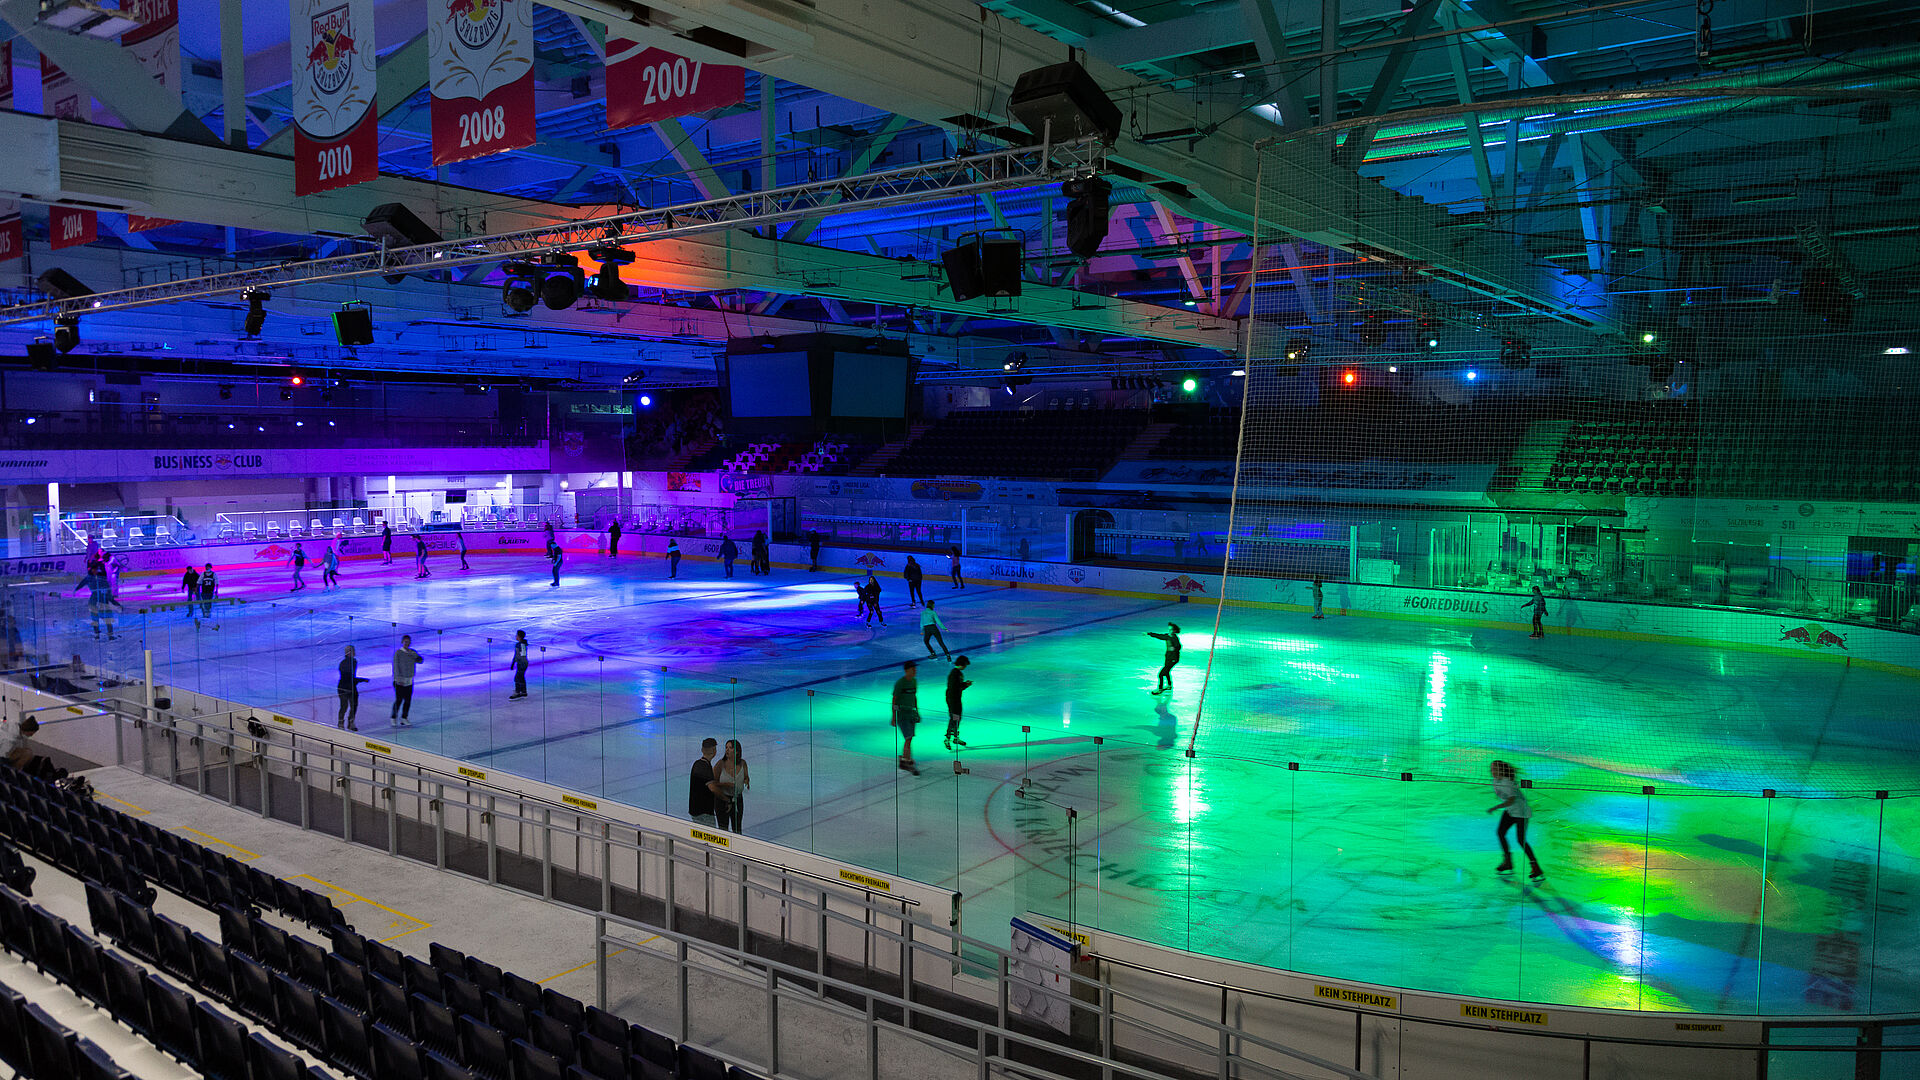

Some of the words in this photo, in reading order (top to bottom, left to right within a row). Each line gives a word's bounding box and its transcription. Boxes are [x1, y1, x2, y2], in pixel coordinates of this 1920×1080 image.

[460, 10, 499, 42] SALZBURG
[642, 57, 702, 105] 2007
[459, 105, 505, 147] 2008
[318, 144, 352, 180] 2010
[62, 213, 83, 241] 2014
[154, 455, 213, 469] BUSINESS
[233, 455, 263, 468] CLUB
[990, 564, 1035, 579] SALZBURG
[1403, 595, 1489, 614] #GOREDBULLS
[692, 830, 703, 840] KEIN
[703, 832, 727, 846] STEHPLATZ
[865, 875, 890, 890] FREIHALTEN
[1319, 986, 1340, 999] KEIN
[1342, 990, 1391, 1007] STEHPLATZ
[1465, 1005, 1488, 1018] KEIN
[1490, 1008, 1542, 1024] STEHPLATZ
